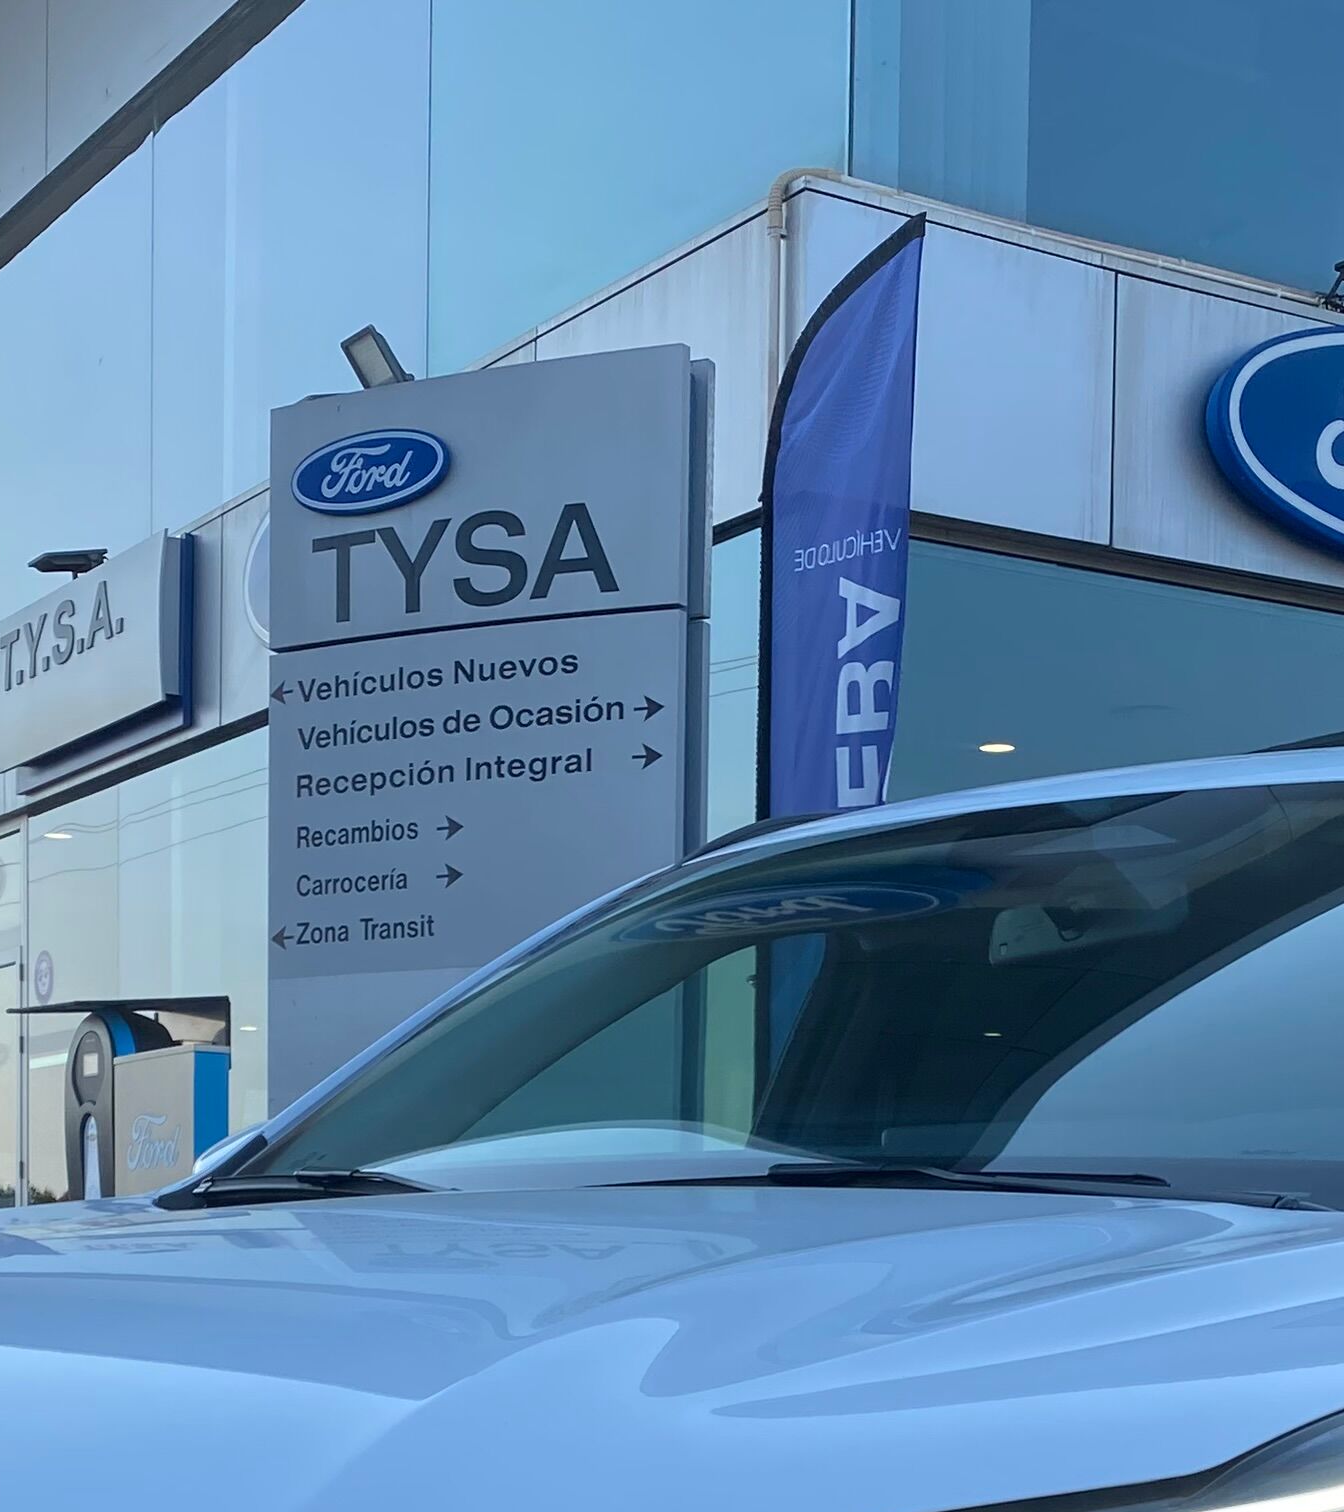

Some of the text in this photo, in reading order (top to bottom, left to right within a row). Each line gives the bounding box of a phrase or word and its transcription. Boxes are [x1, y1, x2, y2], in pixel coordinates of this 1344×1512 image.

[321, 443, 413, 498] Ford
[311, 502, 620, 622] TYSA
[0, 580, 125, 691] T.Y.S.A.
[297, 652, 580, 704] Vehículos Nuevos
[297, 697, 625, 752] Vehículos de Ocasión
[296, 747, 594, 802] Recepción Integral
[296, 817, 419, 850] Recambios
[296, 869, 408, 899] Carrocería
[296, 914, 435, 946] Zona Transit
[128, 1113, 181, 1170] Ford
